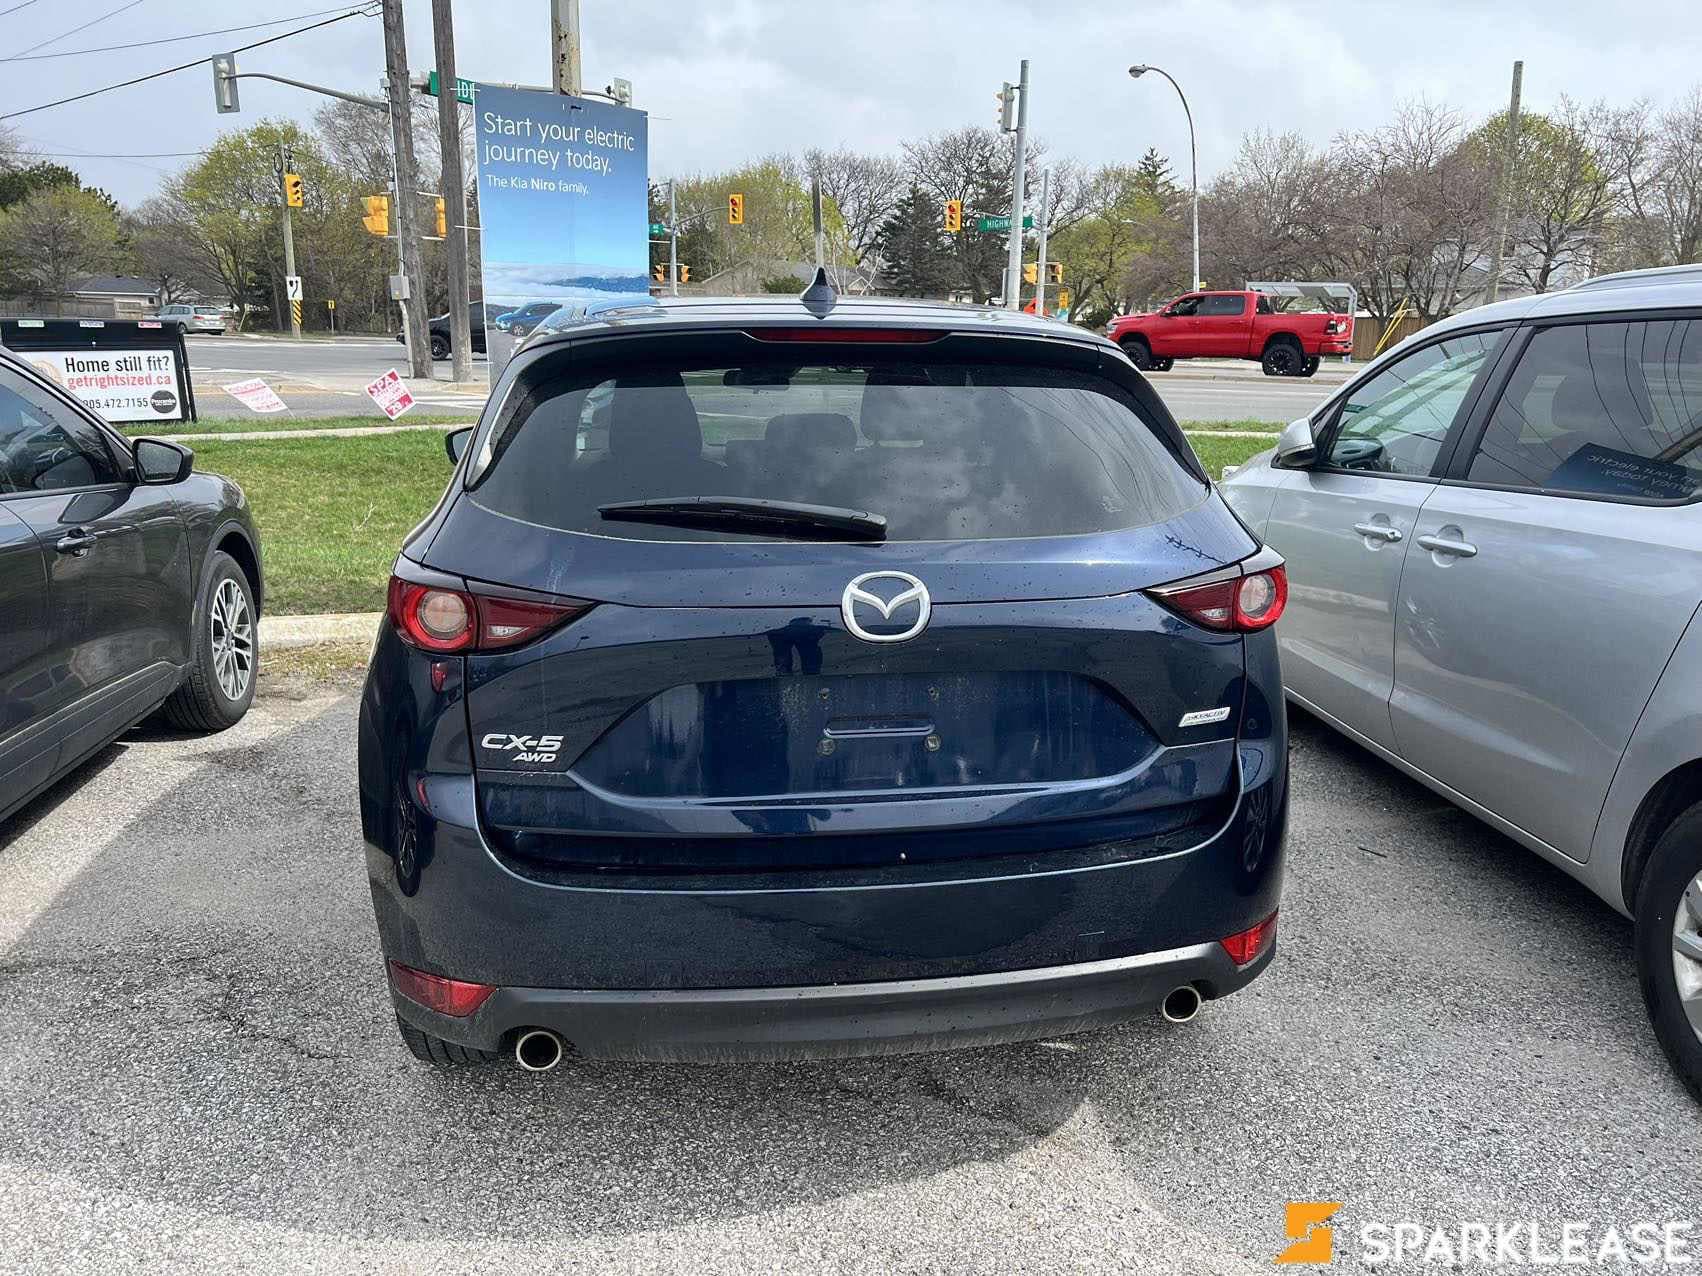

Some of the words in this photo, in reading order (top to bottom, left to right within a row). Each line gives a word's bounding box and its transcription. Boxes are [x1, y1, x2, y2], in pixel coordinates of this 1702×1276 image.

[483, 112, 532, 137] Start
[538, 122, 581, 143] your
[585, 125, 635, 151] electric
[483, 140, 560, 170] journey
[567, 148, 612, 176] today.
[486, 174, 508, 188] The
[510, 176, 528, 190] Kia
[531, 179, 556, 192] Niro
[558, 180, 590, 196] family.
[987, 219, 1012, 228] HIGHWA
[64, 356, 110, 373] Home
[115, 356, 143, 372] still
[147, 355, 170, 371] fit?
[67, 373, 171, 390] getrightsized.ca
[481, 733, 564, 752] CX-5
[512, 752, 557, 763] AWD
